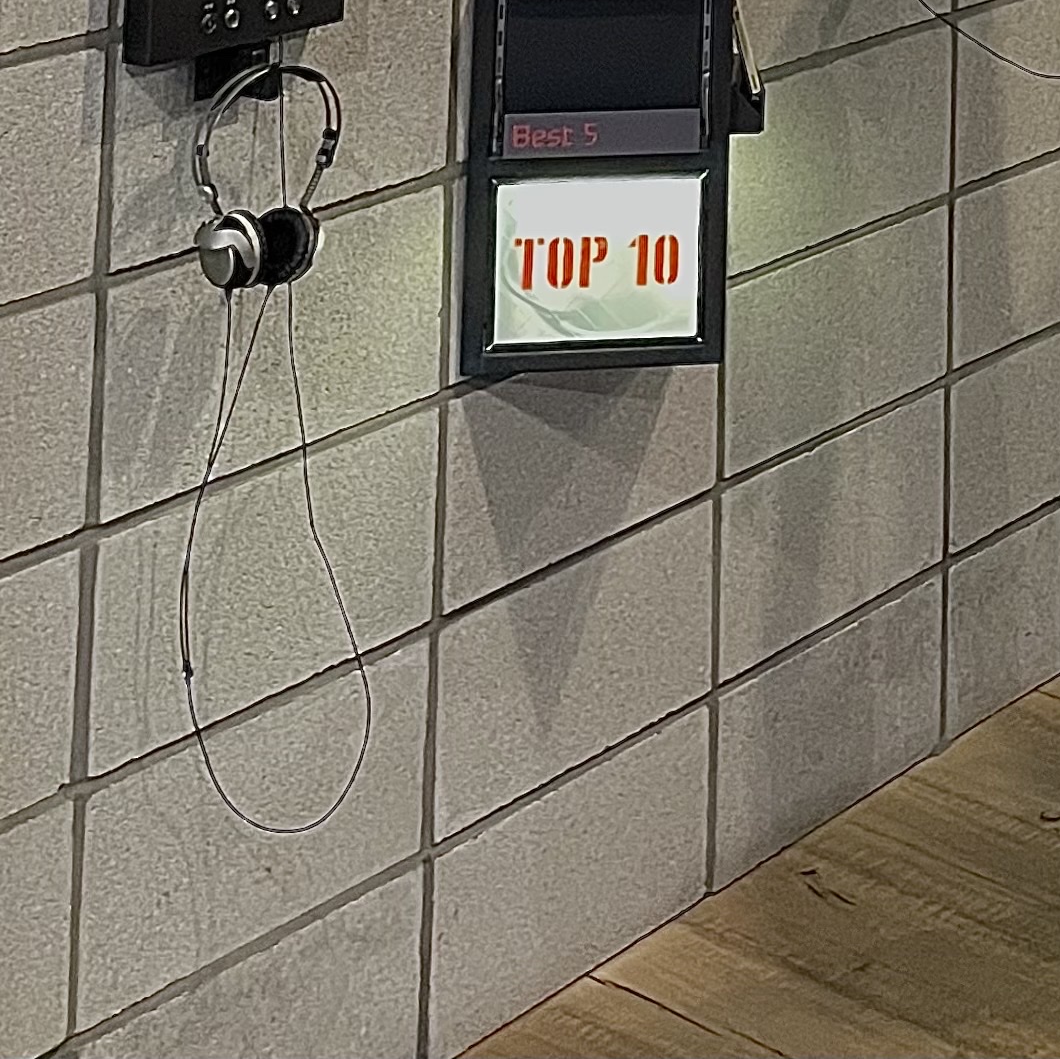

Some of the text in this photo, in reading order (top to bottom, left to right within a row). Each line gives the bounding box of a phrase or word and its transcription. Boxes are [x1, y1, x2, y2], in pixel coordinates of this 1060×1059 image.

[511, 122, 600, 149] Best 5
[514, 234, 680, 291] TOP 10
